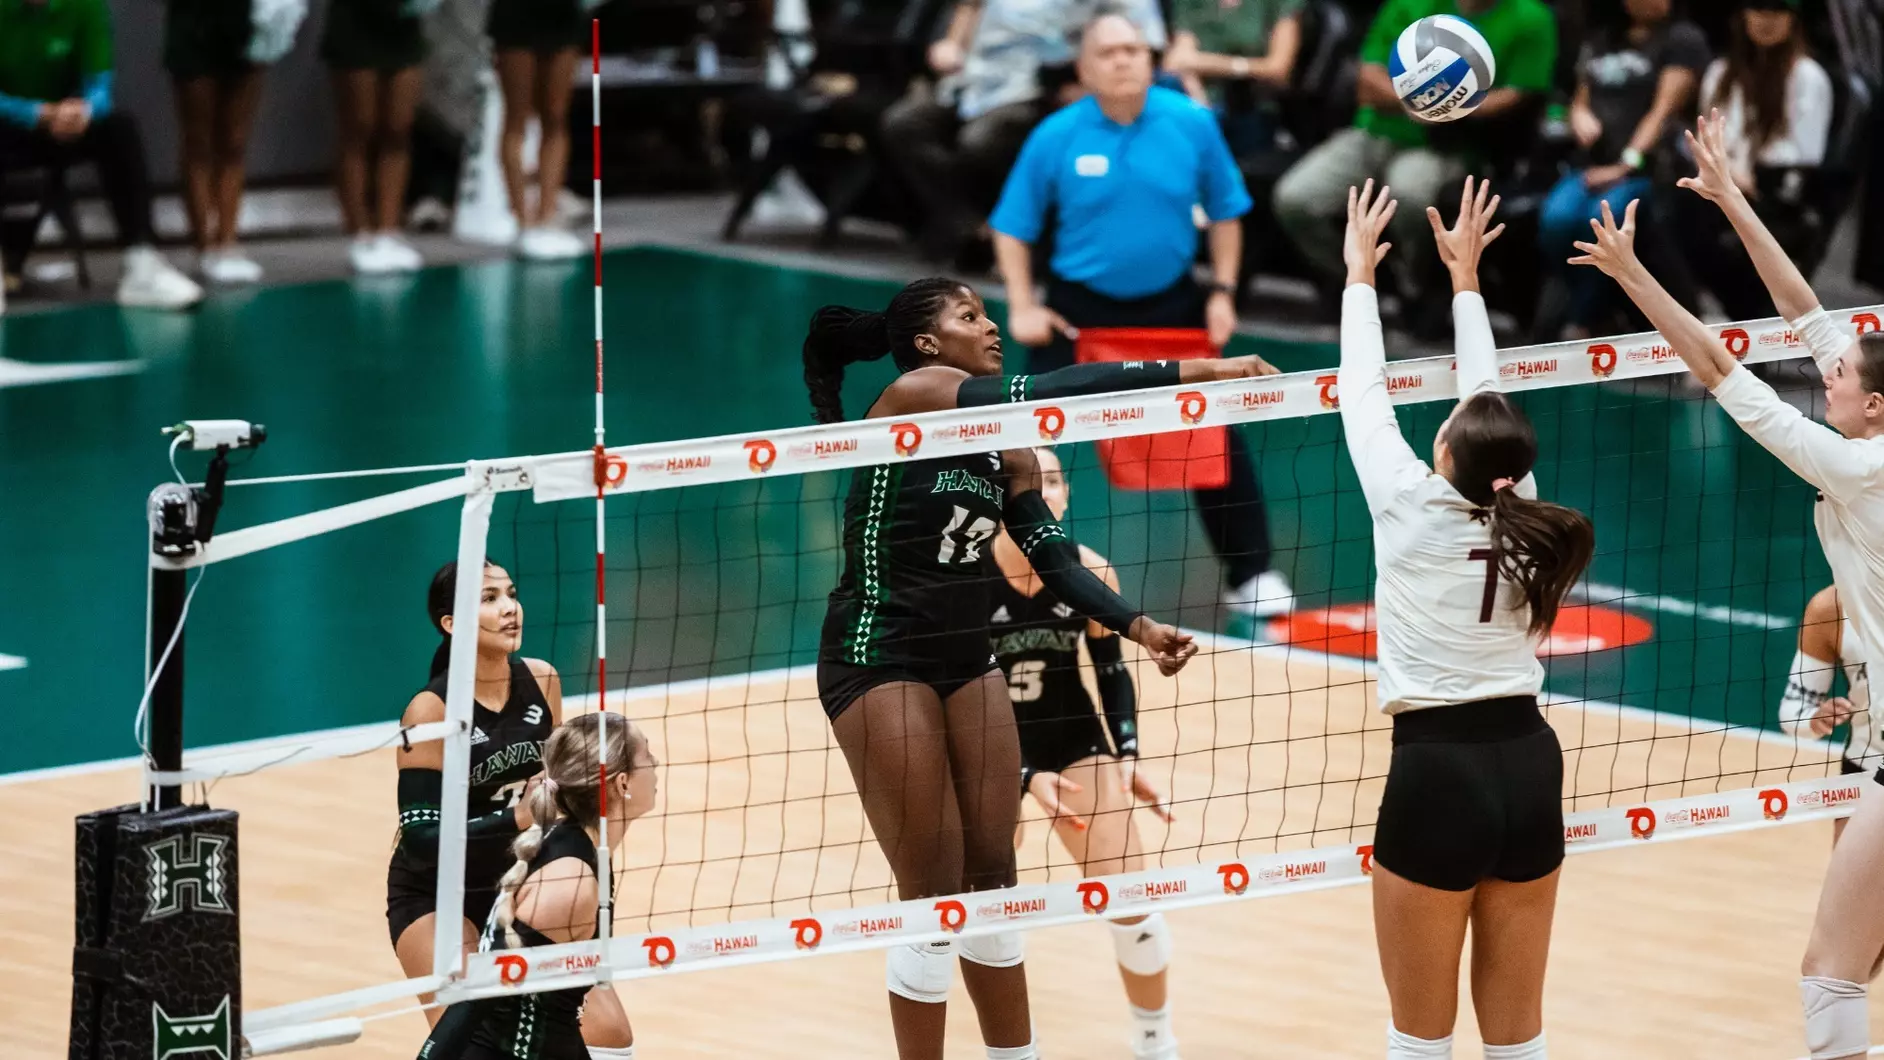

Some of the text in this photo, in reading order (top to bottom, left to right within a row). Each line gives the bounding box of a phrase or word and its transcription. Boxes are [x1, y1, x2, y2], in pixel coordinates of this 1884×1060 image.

[1651, 345, 1679, 360] HAW
[1517, 359, 1557, 375] HAWAII
[1243, 390, 1284, 407] HAWAII
[1102, 407, 1144, 423] HAWAII
[959, 422, 1001, 438] HAWAII
[815, 439, 858, 455] HAWAII
[666, 456, 711, 471] HAWAII
[1008, 660, 1046, 702] 5
[1822, 787, 1860, 803] HAWAII
[1690, 805, 1729, 822] HAWAII
[1566, 824, 1596, 839] AWAII
[1285, 861, 1326, 877] HAWAII
[1145, 880, 1186, 897] HAWAII
[1004, 899, 1046, 915] HAWAII
[860, 917, 902, 933] HAWAII
[714, 935, 758, 952] HAWAII
[566, 954, 600, 970] HAWA
